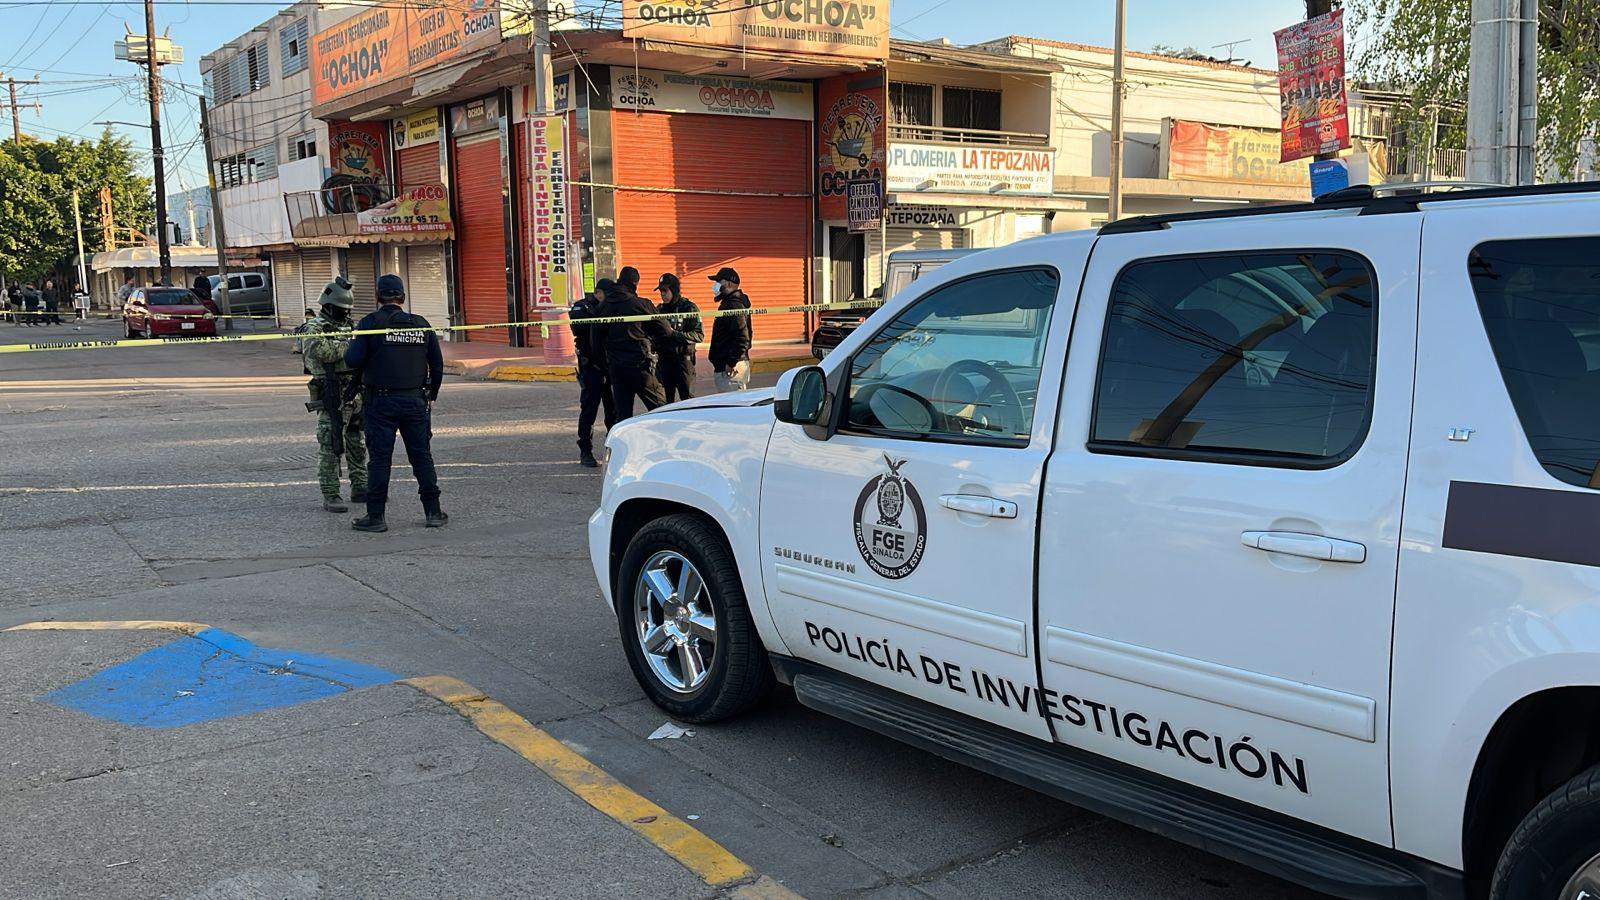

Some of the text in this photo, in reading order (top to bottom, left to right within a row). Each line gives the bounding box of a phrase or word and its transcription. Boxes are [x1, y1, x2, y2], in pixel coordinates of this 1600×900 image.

[348, 9, 390, 43] REFACCIONARIA
[419, 10, 445, 37] LIDER EN
[463, 13, 496, 36] OCHOA
[639, 4, 711, 28] OCHOA
[778, 26, 784, 38] Y
[784, 27, 806, 41] LIDER
[807, 29, 817, 42] EN
[1319, 33, 1338, 44] RICA
[1279, 61, 1297, 73] SAB.
[1300, 56, 1309, 68] 10
[1310, 53, 1319, 65] de
[1321, 47, 1341, 61] FEB.
[617, 73, 658, 90] FERRETERIA
[619, 94, 656, 107] OCHOA
[699, 86, 775, 110] OCHOA
[467, 106, 484, 119] OCHOA
[821, 92, 882, 134] FERRETERIA
[894, 149, 1050, 172] PLOMERIA LA TEPOZANA
[850, 183, 876, 197] OFERTA
[533, 120, 552, 303] OFERTA PINTURA VINILICA
[550, 151, 566, 273] FERRETERIA OCHOA
[849, 196, 880, 209] PINTURA
[849, 209, 880, 222] VINILICA
[891, 213, 955, 225] TEPOZANA
[386, 335, 424, 344] MUNICIPAL
[873, 529, 905, 552] FGE
[774, 546, 855, 574] SUBURBAN
[869, 559, 898, 577] GENERAL
[898, 565, 911, 576] DEL
[909, 534, 924, 567] ESTADO
[872, 547, 904, 561] SINALOA
[804, 621, 1309, 794] POLICÍA DE INVESTIGACIÓN
